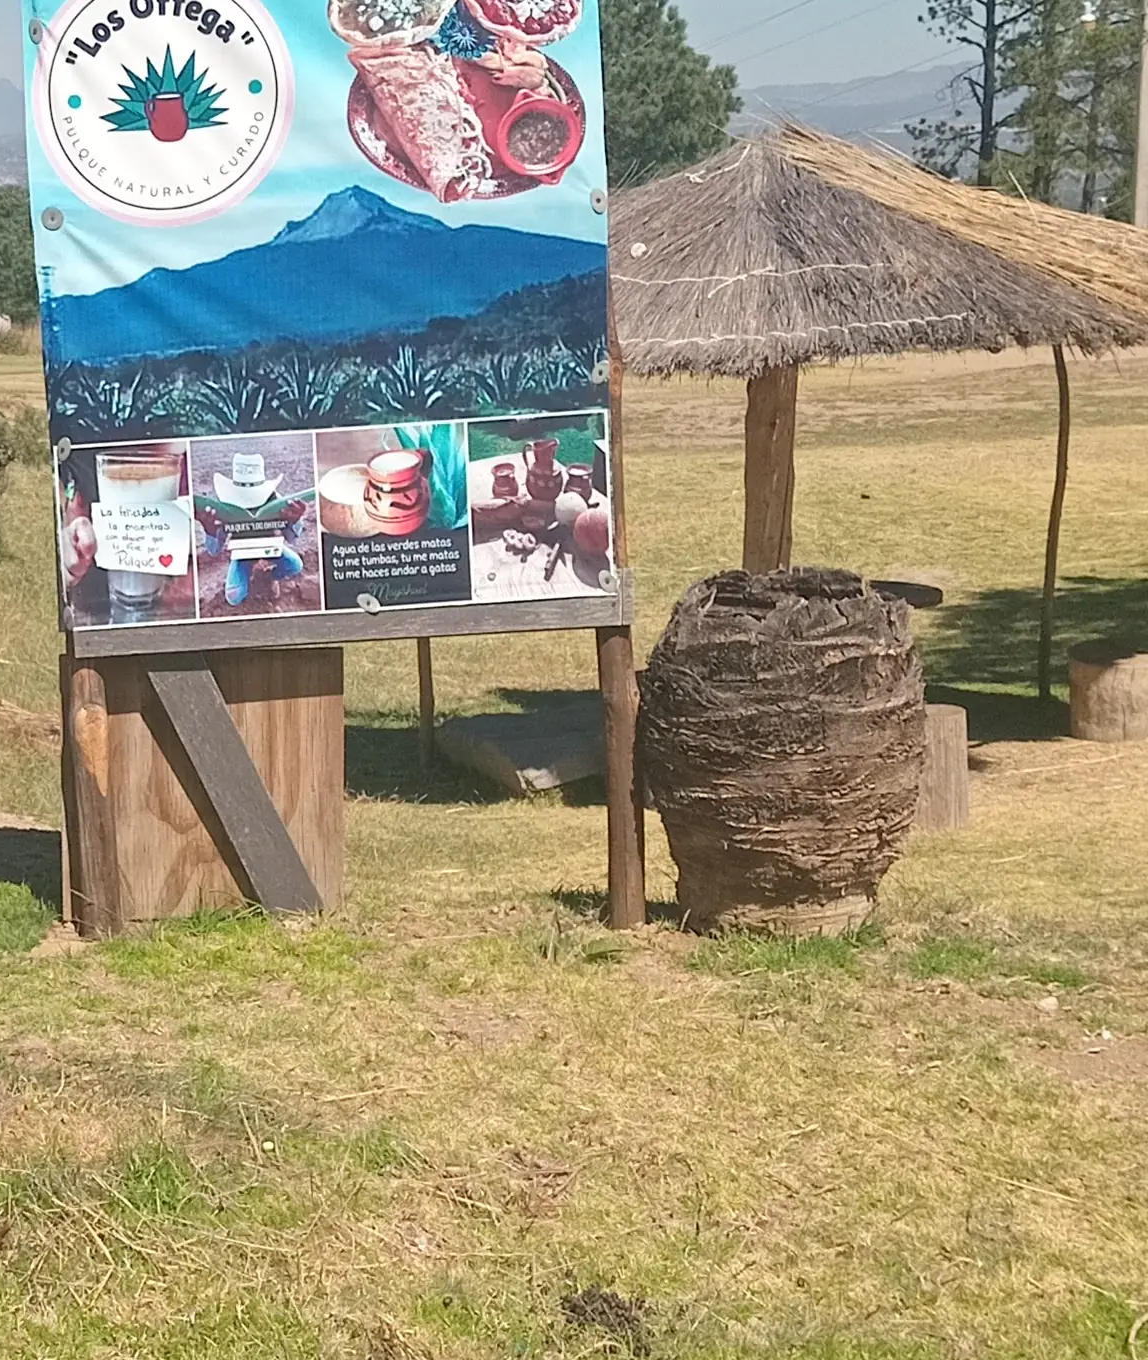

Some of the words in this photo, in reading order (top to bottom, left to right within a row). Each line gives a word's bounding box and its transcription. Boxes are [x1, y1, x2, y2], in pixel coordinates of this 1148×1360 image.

[62, 116, 107, 177] PULQUE
[113, 176, 195, 197] NATURAL
[203, 176, 213, 186] Y
[219, 111, 265, 175] CURADO
[332, 544, 356, 557] Agua
[357, 542, 370, 553] de
[371, 541, 386, 552] las
[387, 539, 420, 551] verdes
[421, 538, 452, 549] matas
[332, 557, 344, 568] tu
[345, 557, 360, 566] me
[361, 554, 399, 565] tumbas,
[401, 552, 412, 563] tu
[413, 552, 428, 562] me
[429, 550, 460, 560] matas
[333, 570, 345, 580] tu
[346, 569, 361, 579] me
[361, 567, 390, 578] haces
[391, 565, 420, 576] andar
[420, 565, 428, 574] a
[429, 563, 457, 576] gatas
